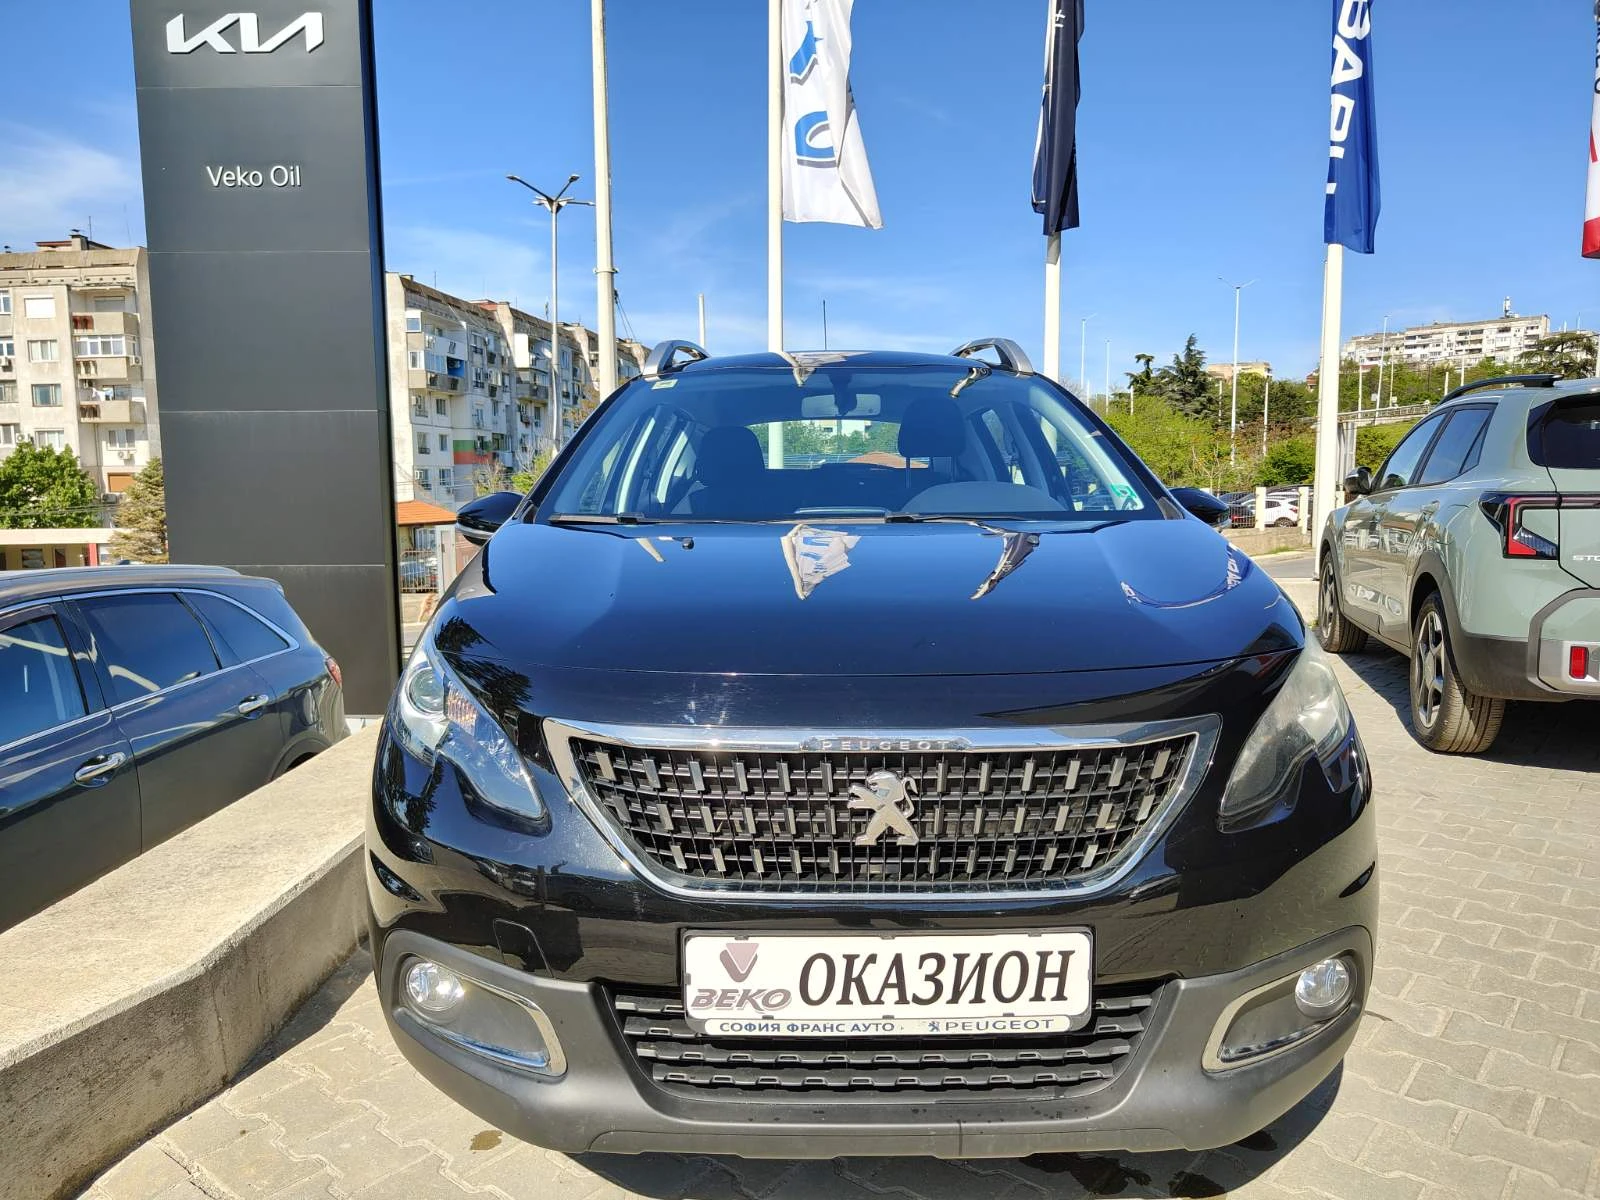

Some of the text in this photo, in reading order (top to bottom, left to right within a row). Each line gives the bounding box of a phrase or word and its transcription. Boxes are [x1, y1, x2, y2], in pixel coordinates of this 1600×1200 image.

[166, 12, 324, 53] KIA
[206, 165, 302, 188] Veko Oil
[821, 740, 950, 750] PEUGEOT
[799, 950, 1076, 1007] ОКАЗИОН
[719, 1021, 895, 1034] СОФИЯ ФРАНС АУТО
[945, 1018, 1055, 1032] PEUGEOT
